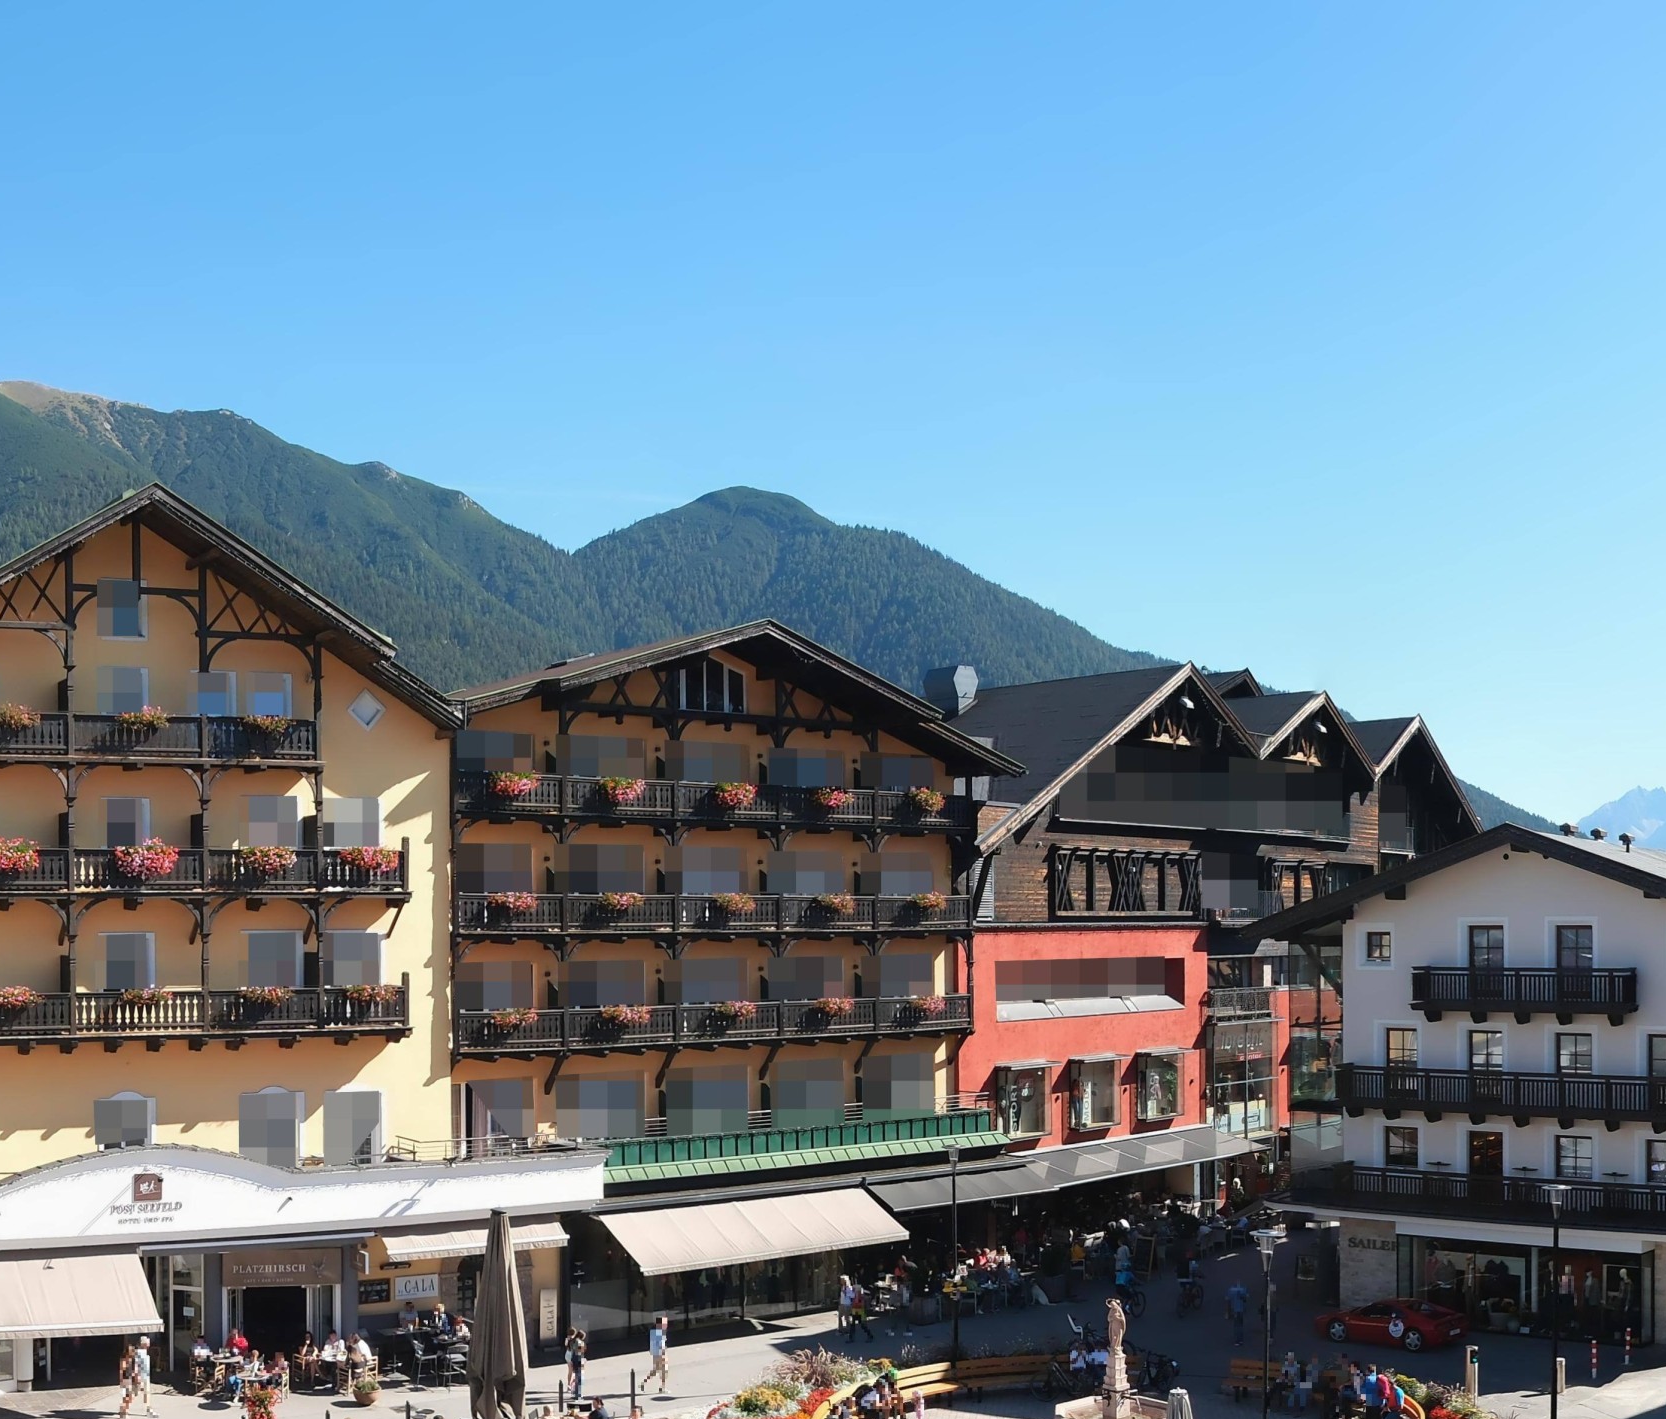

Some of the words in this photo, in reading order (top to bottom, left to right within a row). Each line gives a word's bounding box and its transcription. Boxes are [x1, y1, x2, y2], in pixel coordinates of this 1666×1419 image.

[1010, 1084, 1018, 1131] SPORT
[137, 1201, 182, 1214] SEEFELD
[232, 1263, 306, 1274] PLATZHIRSCH
